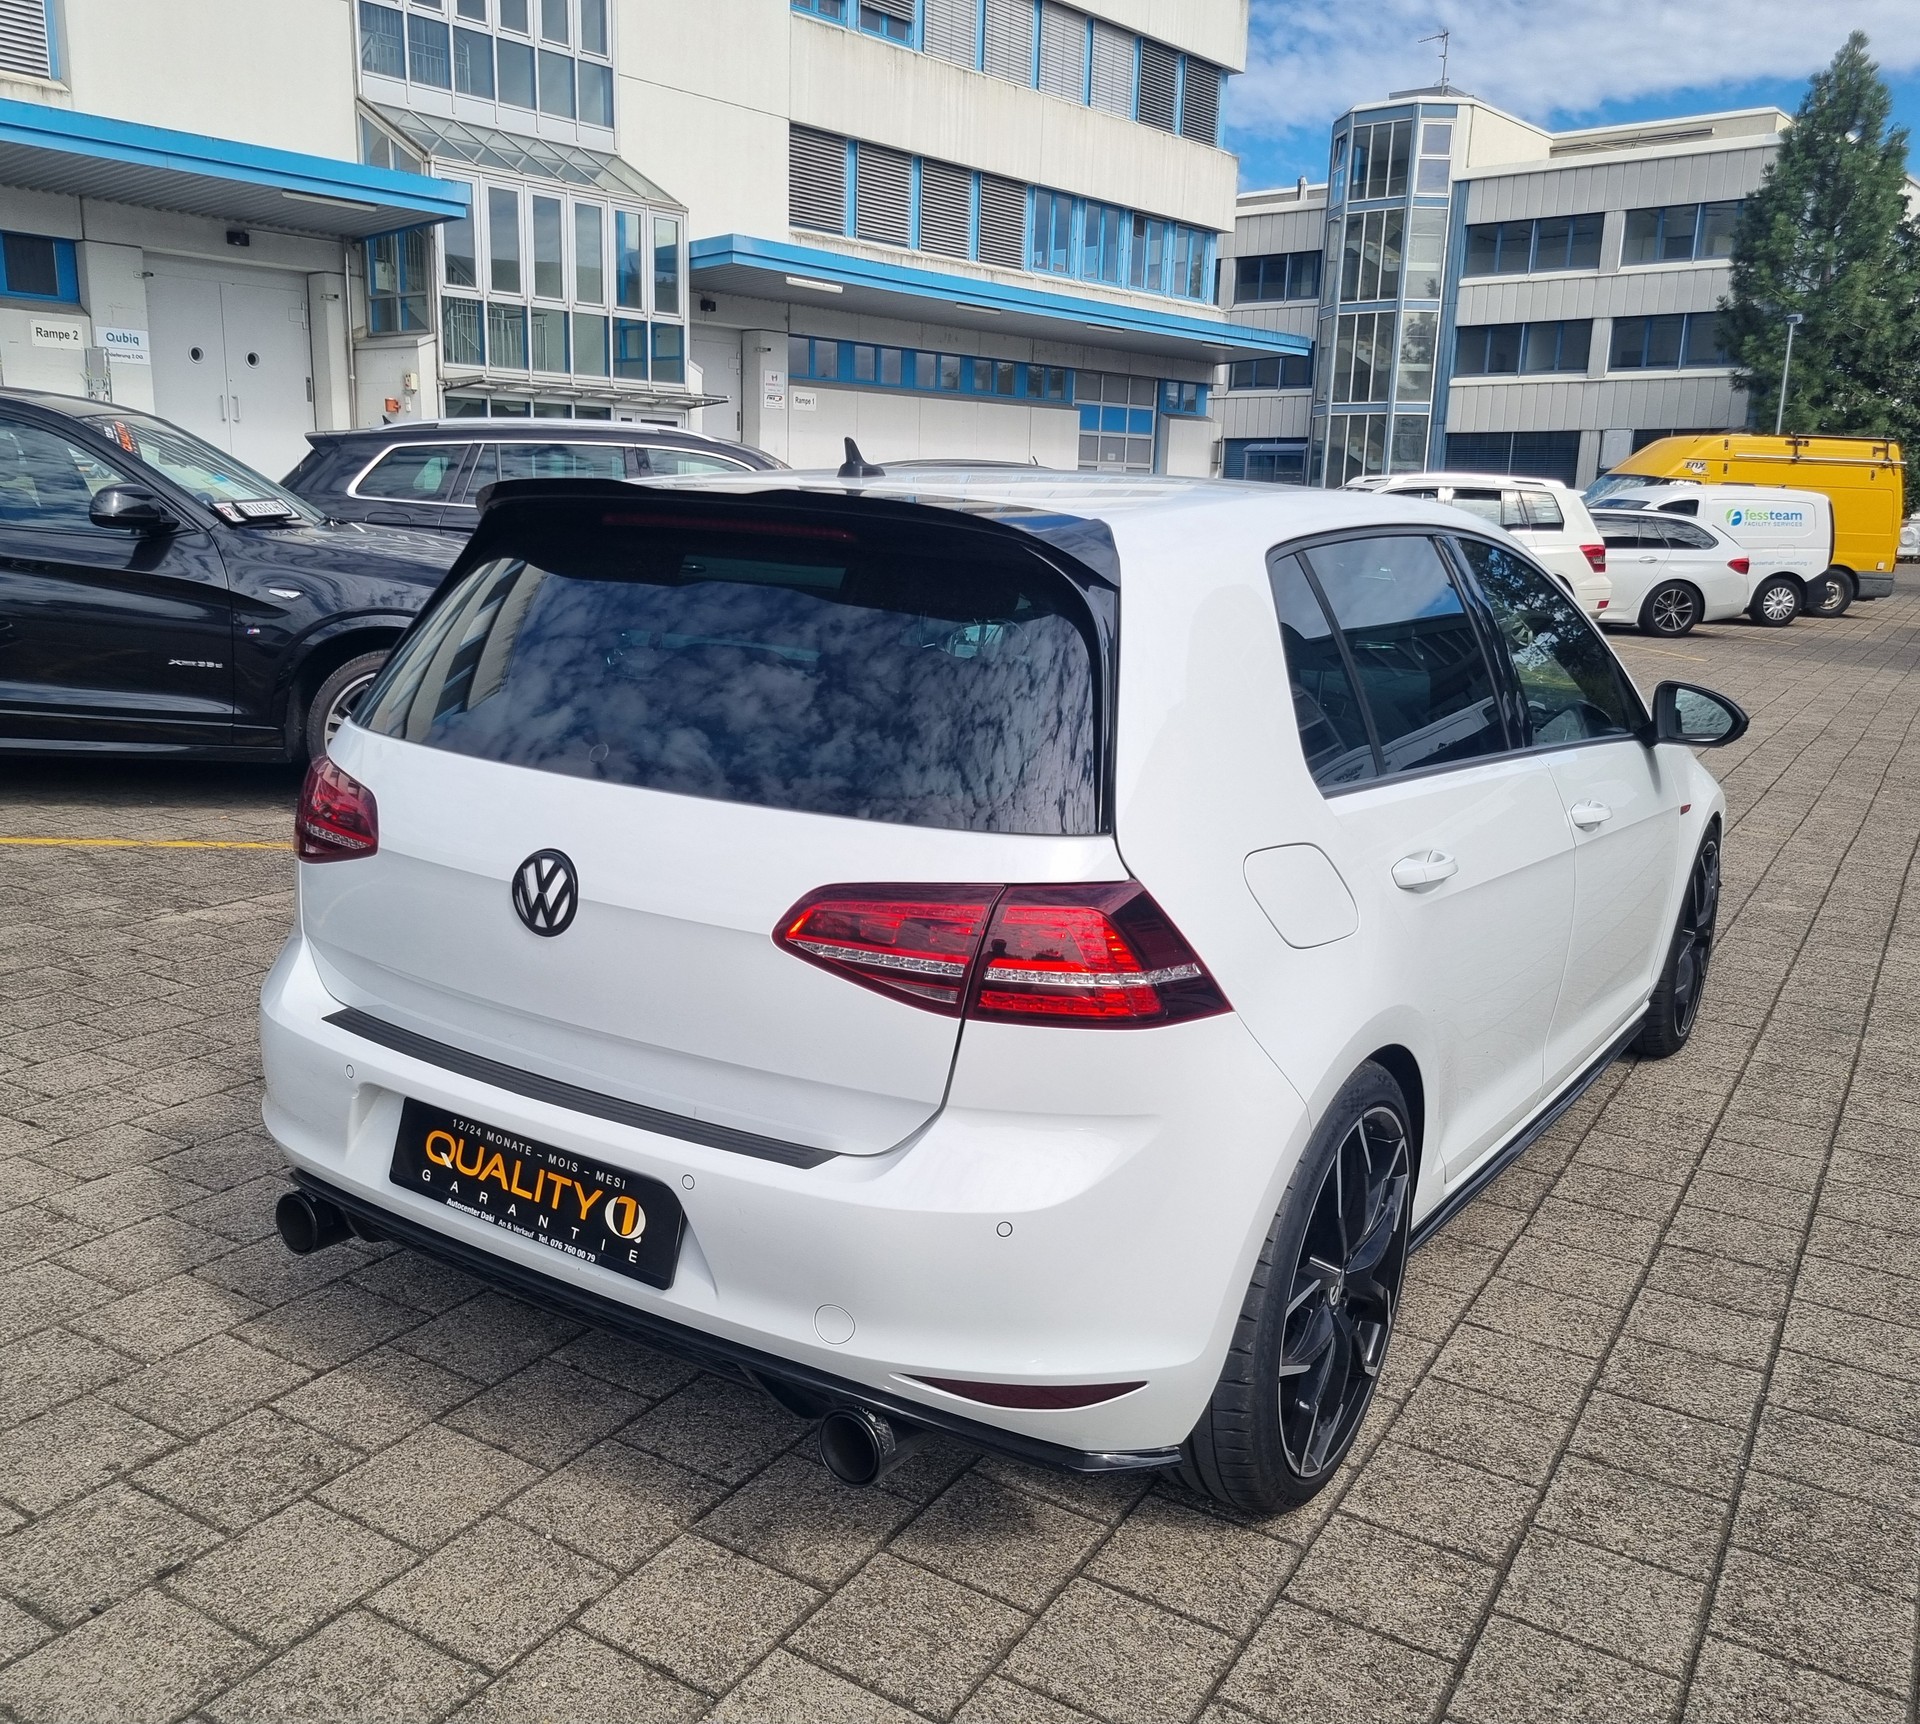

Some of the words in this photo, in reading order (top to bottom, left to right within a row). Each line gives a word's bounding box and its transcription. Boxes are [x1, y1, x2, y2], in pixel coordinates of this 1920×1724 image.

[35, 327, 70, 341] Rampe
[72, 330, 79, 341] 2
[105, 332, 140, 346] Qubiq
[795, 396, 811, 406] Rampe
[1744, 508, 1803, 521] fessteam
[452, 1118, 482, 1137] 12/24
[486, 1130, 532, 1156] MONATE
[548, 1153, 579, 1173] MOIS
[595, 1170, 627, 1190] MESI
[425, 1130, 603, 1221] QUALITY
[421, 1168, 638, 1264] GARANTIE
[446, 1197, 480, 1217] Autocenter
[480, 1211, 496, 1223] Daki
[498, 1219, 507, 1228] An
[507, 1222, 512, 1230] &
[513, 1224, 535, 1239] Verkauf
[538, 1233, 549, 1245] Tel.
[550, 1238, 563, 1250] 076
[563, 1243, 577, 1255] 760
[576, 1248, 586, 1259] 00
[586, 1252, 596, 1263] 79
